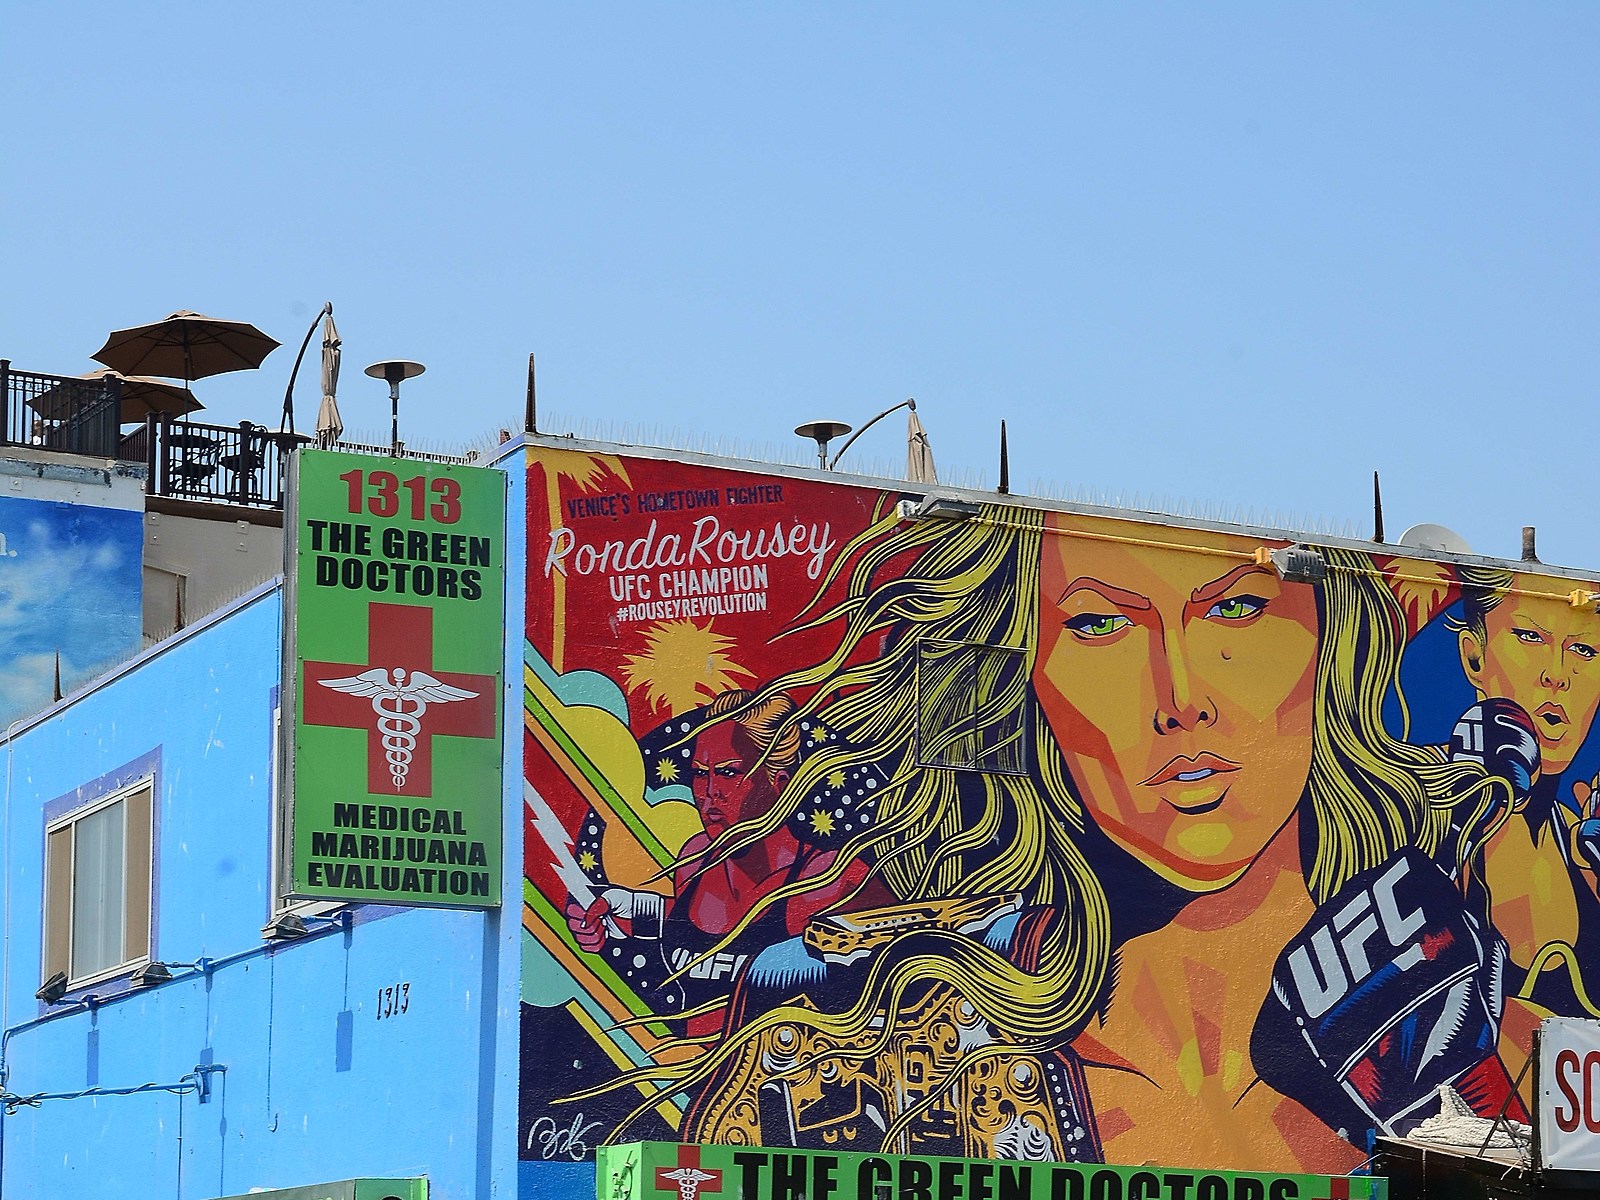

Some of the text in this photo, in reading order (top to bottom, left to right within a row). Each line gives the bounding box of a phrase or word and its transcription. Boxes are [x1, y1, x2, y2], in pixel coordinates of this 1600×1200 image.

[340, 468, 462, 524] 1313
[567, 484, 784, 518] VENICE'S HOMETOWN FIGHTER
[306, 520, 491, 568] THE GREEN
[545, 515, 837, 580] Ronda Rousey
[316, 555, 482, 601] DOCTORS
[609, 563, 769, 602] UFC CHAMPION
[616, 592, 768, 622] #ROUSEYREVOLUTION
[334, 802, 467, 836] MEDICAL
[312, 831, 488, 866] MARIJUANA
[308, 861, 489, 896] EVALUATION
[1288, 856, 1427, 1019] UFC
[377, 983, 410, 1020] 1313
